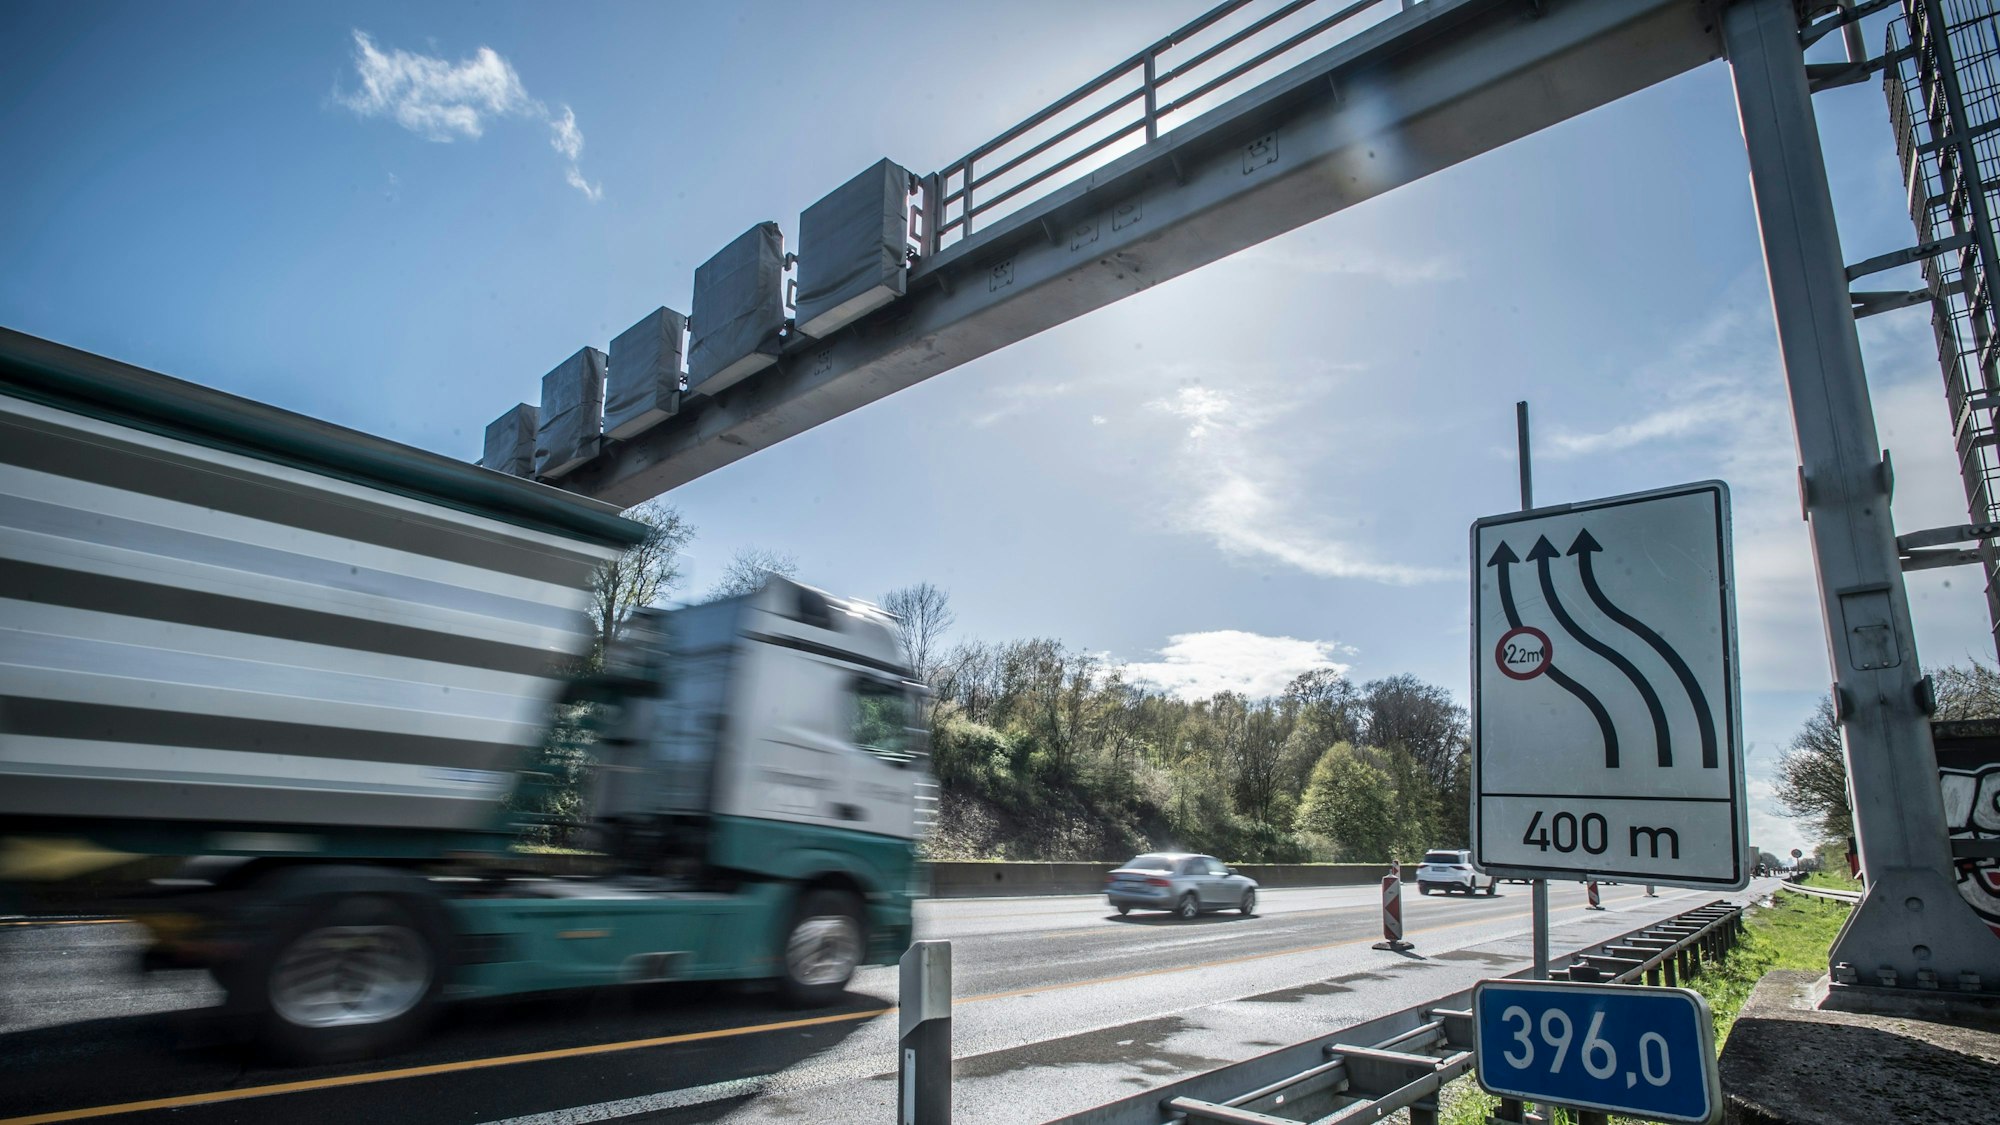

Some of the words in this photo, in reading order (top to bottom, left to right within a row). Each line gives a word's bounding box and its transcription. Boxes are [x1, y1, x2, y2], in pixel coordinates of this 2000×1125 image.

[1522, 811, 1609, 855] 400
[1629, 825, 1680, 860] m
[1501, 1005, 1672, 1089] 396,0
